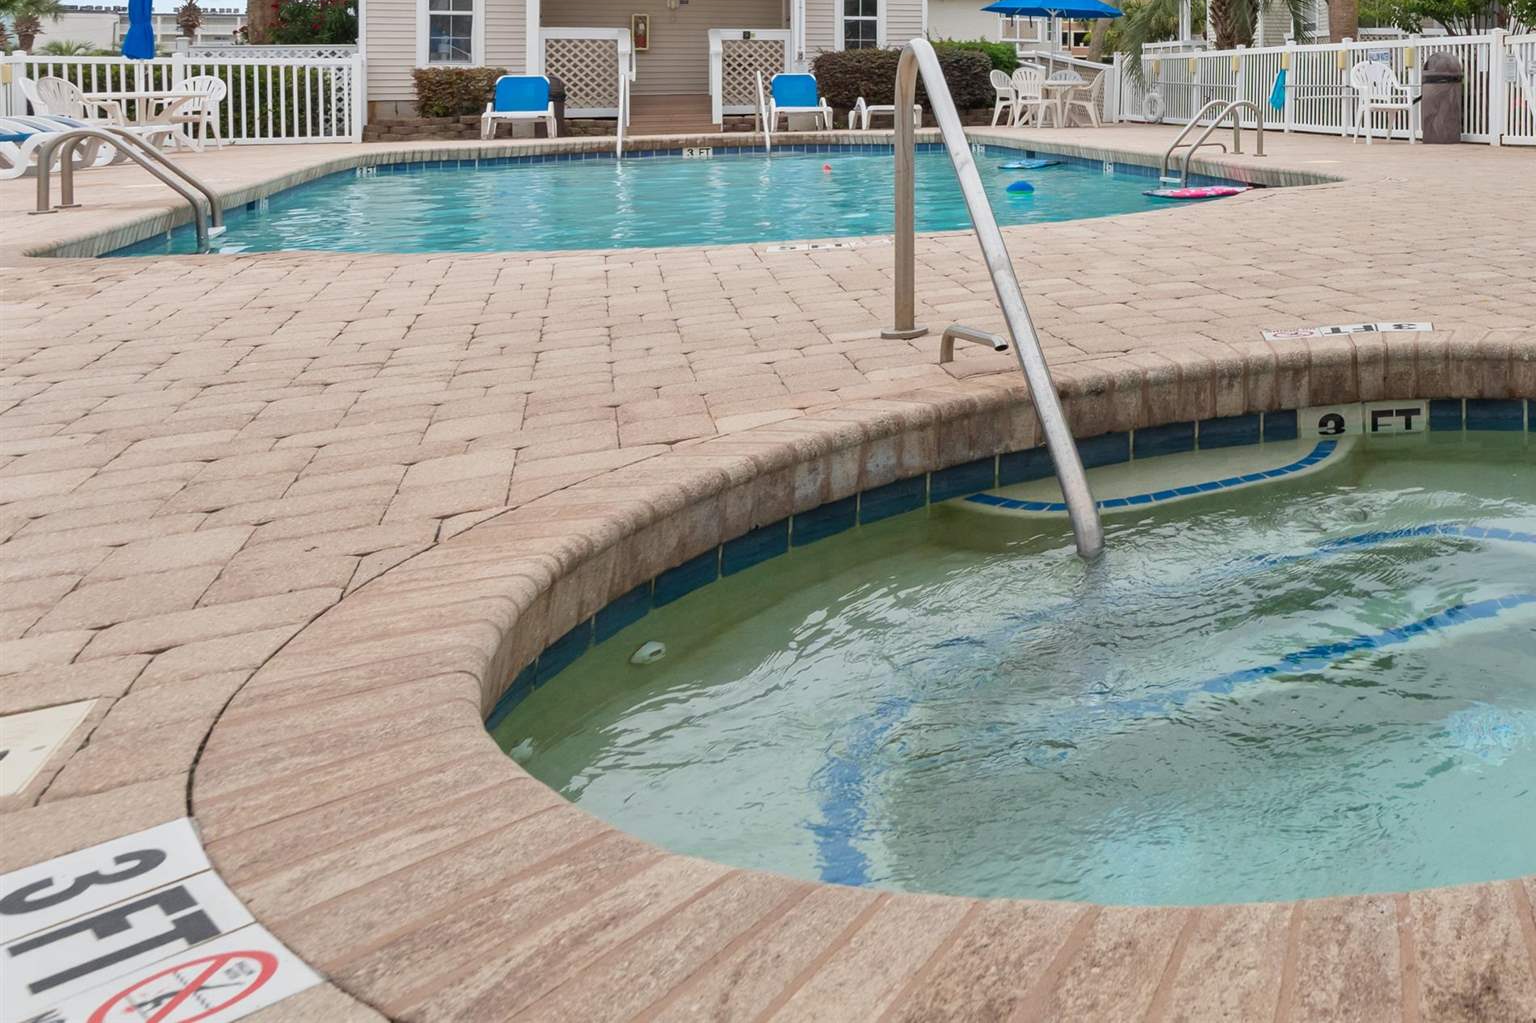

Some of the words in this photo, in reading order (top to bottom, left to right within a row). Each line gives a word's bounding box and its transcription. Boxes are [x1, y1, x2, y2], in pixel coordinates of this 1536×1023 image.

[1371, 408, 1421, 432] FT
[0, 848, 167, 916] 3
[6, 884, 222, 995] FT
